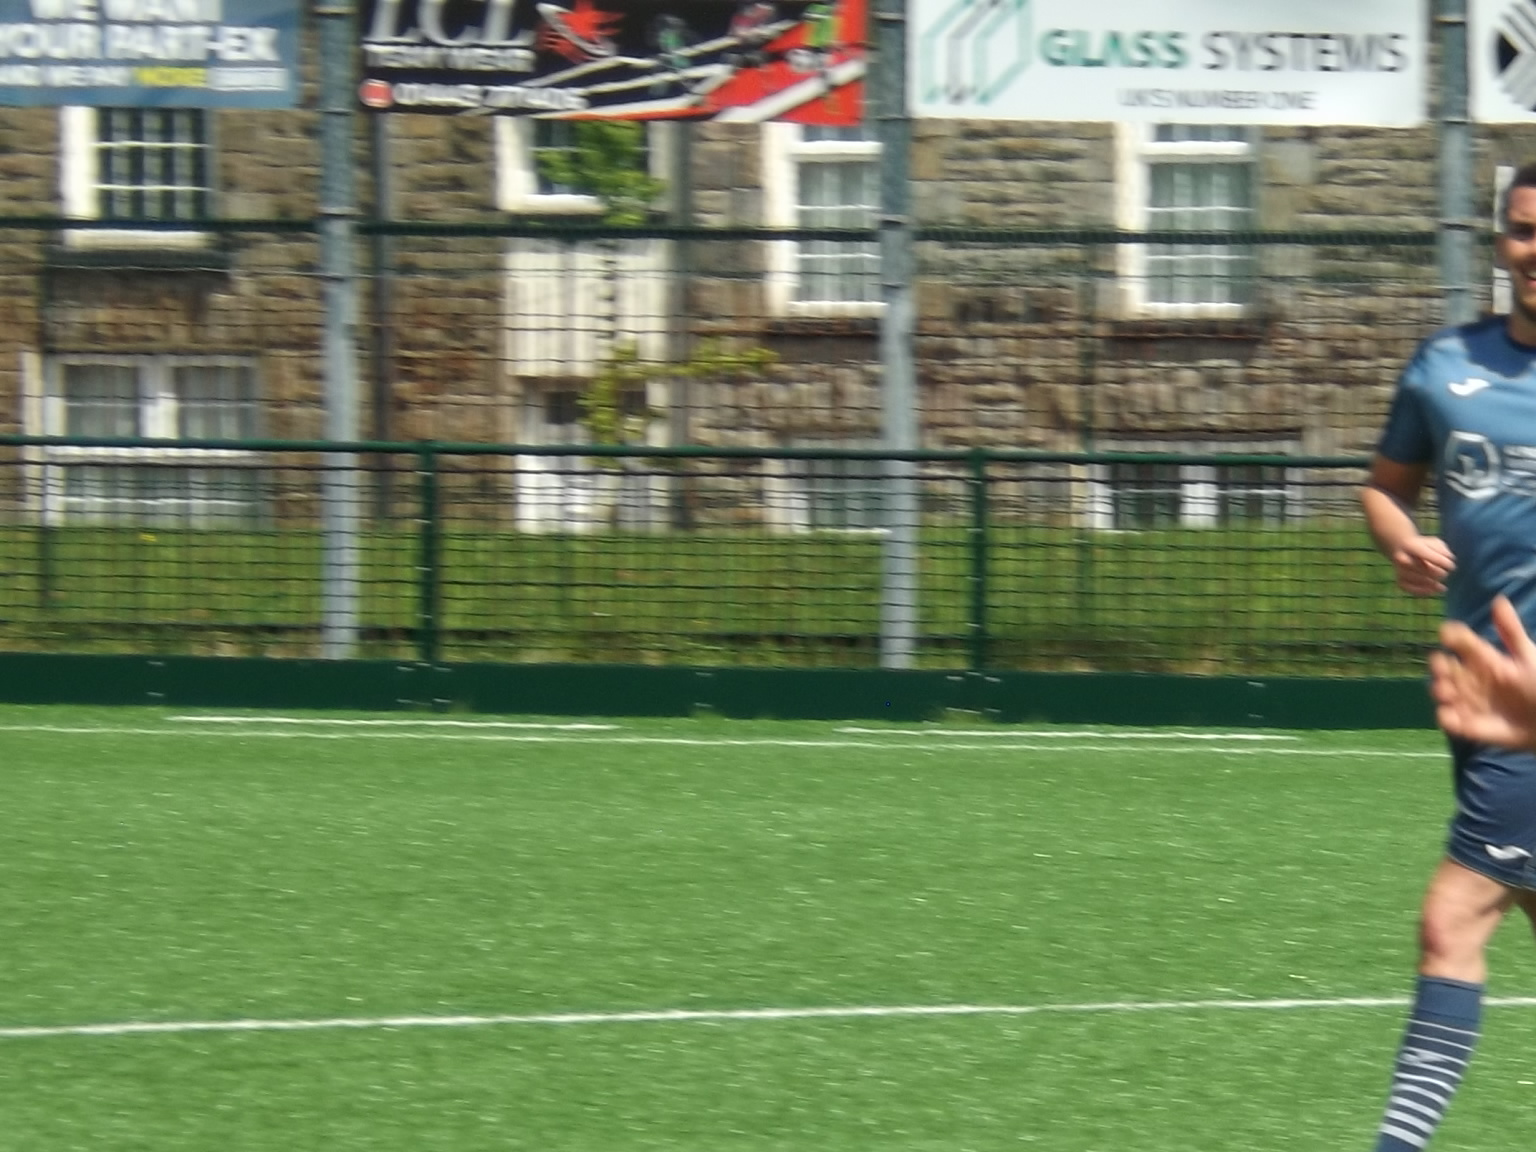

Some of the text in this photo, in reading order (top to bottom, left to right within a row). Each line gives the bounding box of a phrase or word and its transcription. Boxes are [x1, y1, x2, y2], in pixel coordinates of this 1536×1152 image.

[104, 24, 280, 62] PART-EX
[1037, 28, 1411, 73] GLASS SYSTEMS
